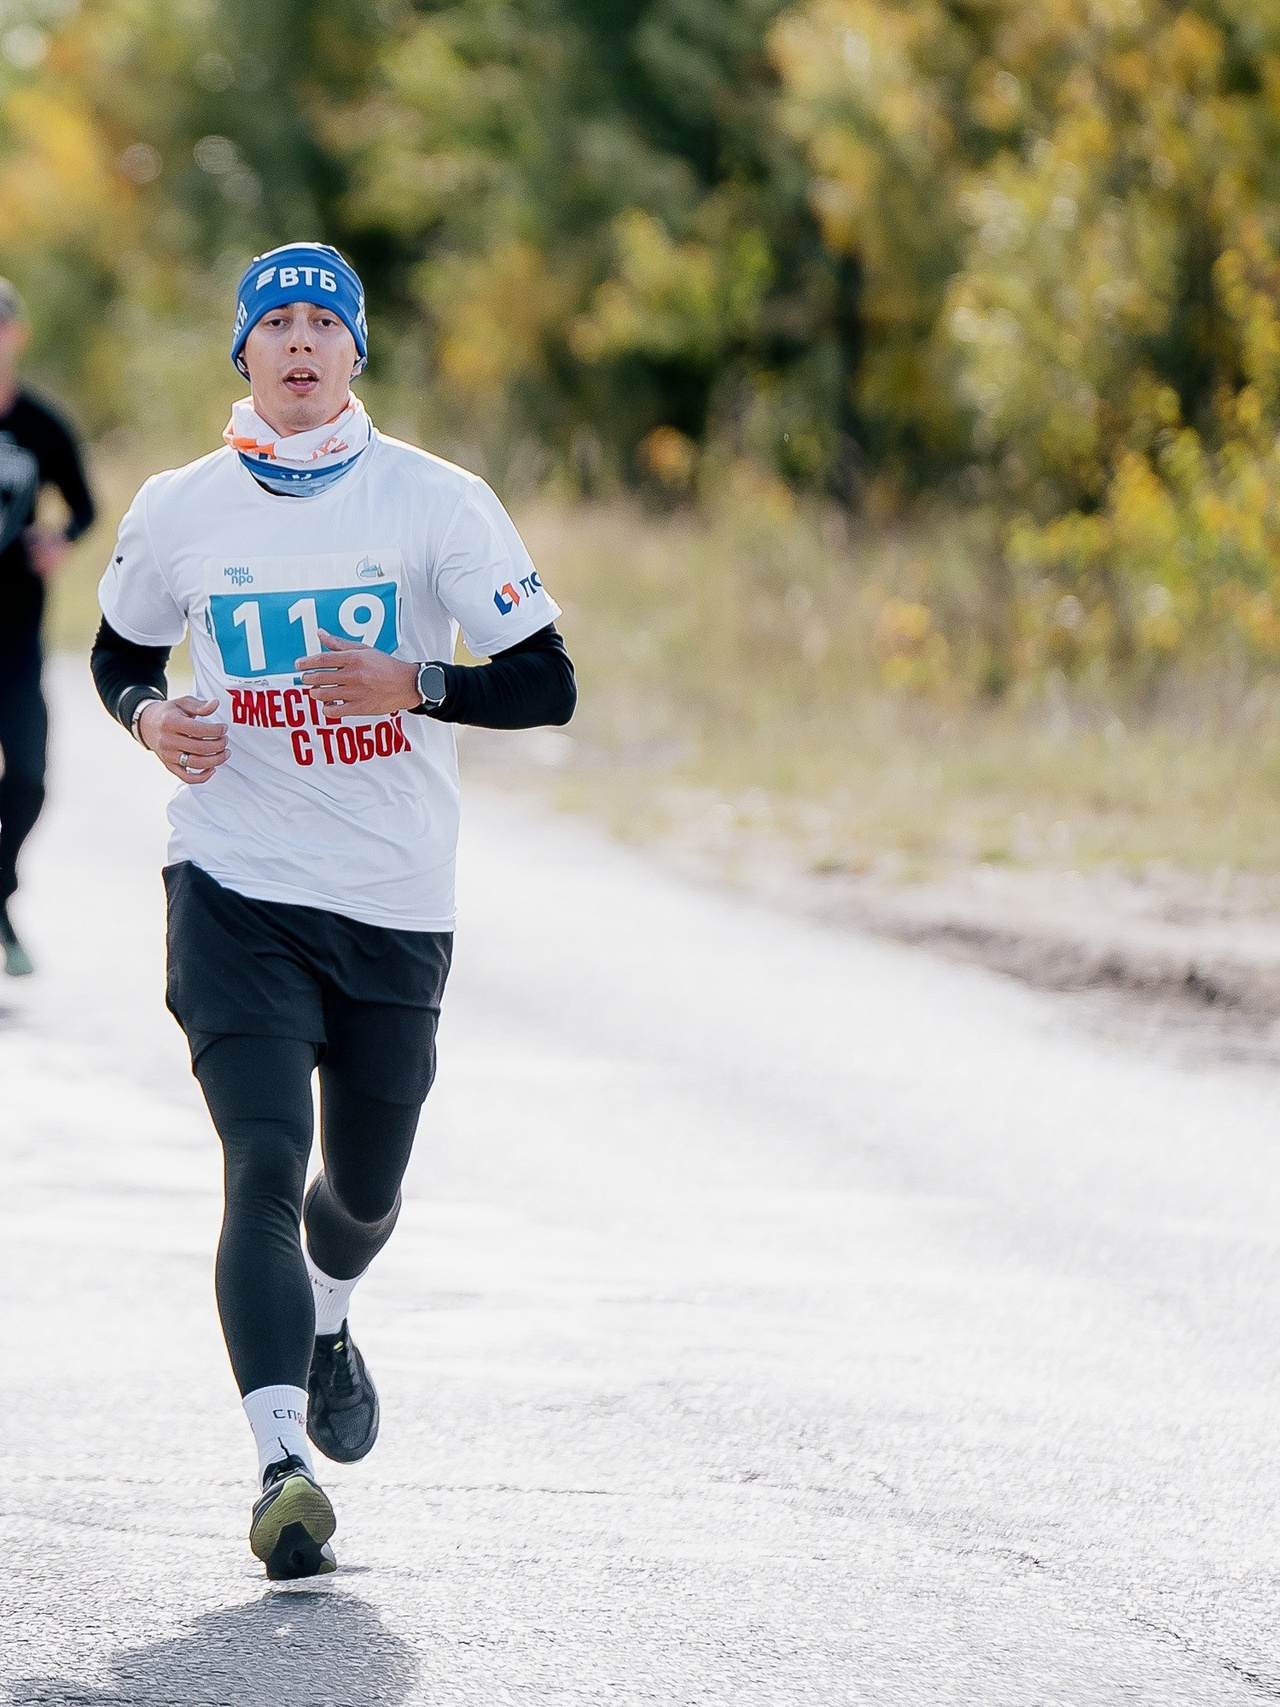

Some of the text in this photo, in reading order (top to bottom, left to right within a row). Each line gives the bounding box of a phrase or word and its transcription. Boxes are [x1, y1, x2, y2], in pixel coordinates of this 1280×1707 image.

[279, 266, 337, 293] ВТБ
[231, 575, 254, 587] про
[232, 593, 386, 672] 119
[291, 709, 412, 766] С ТОБОЙ
